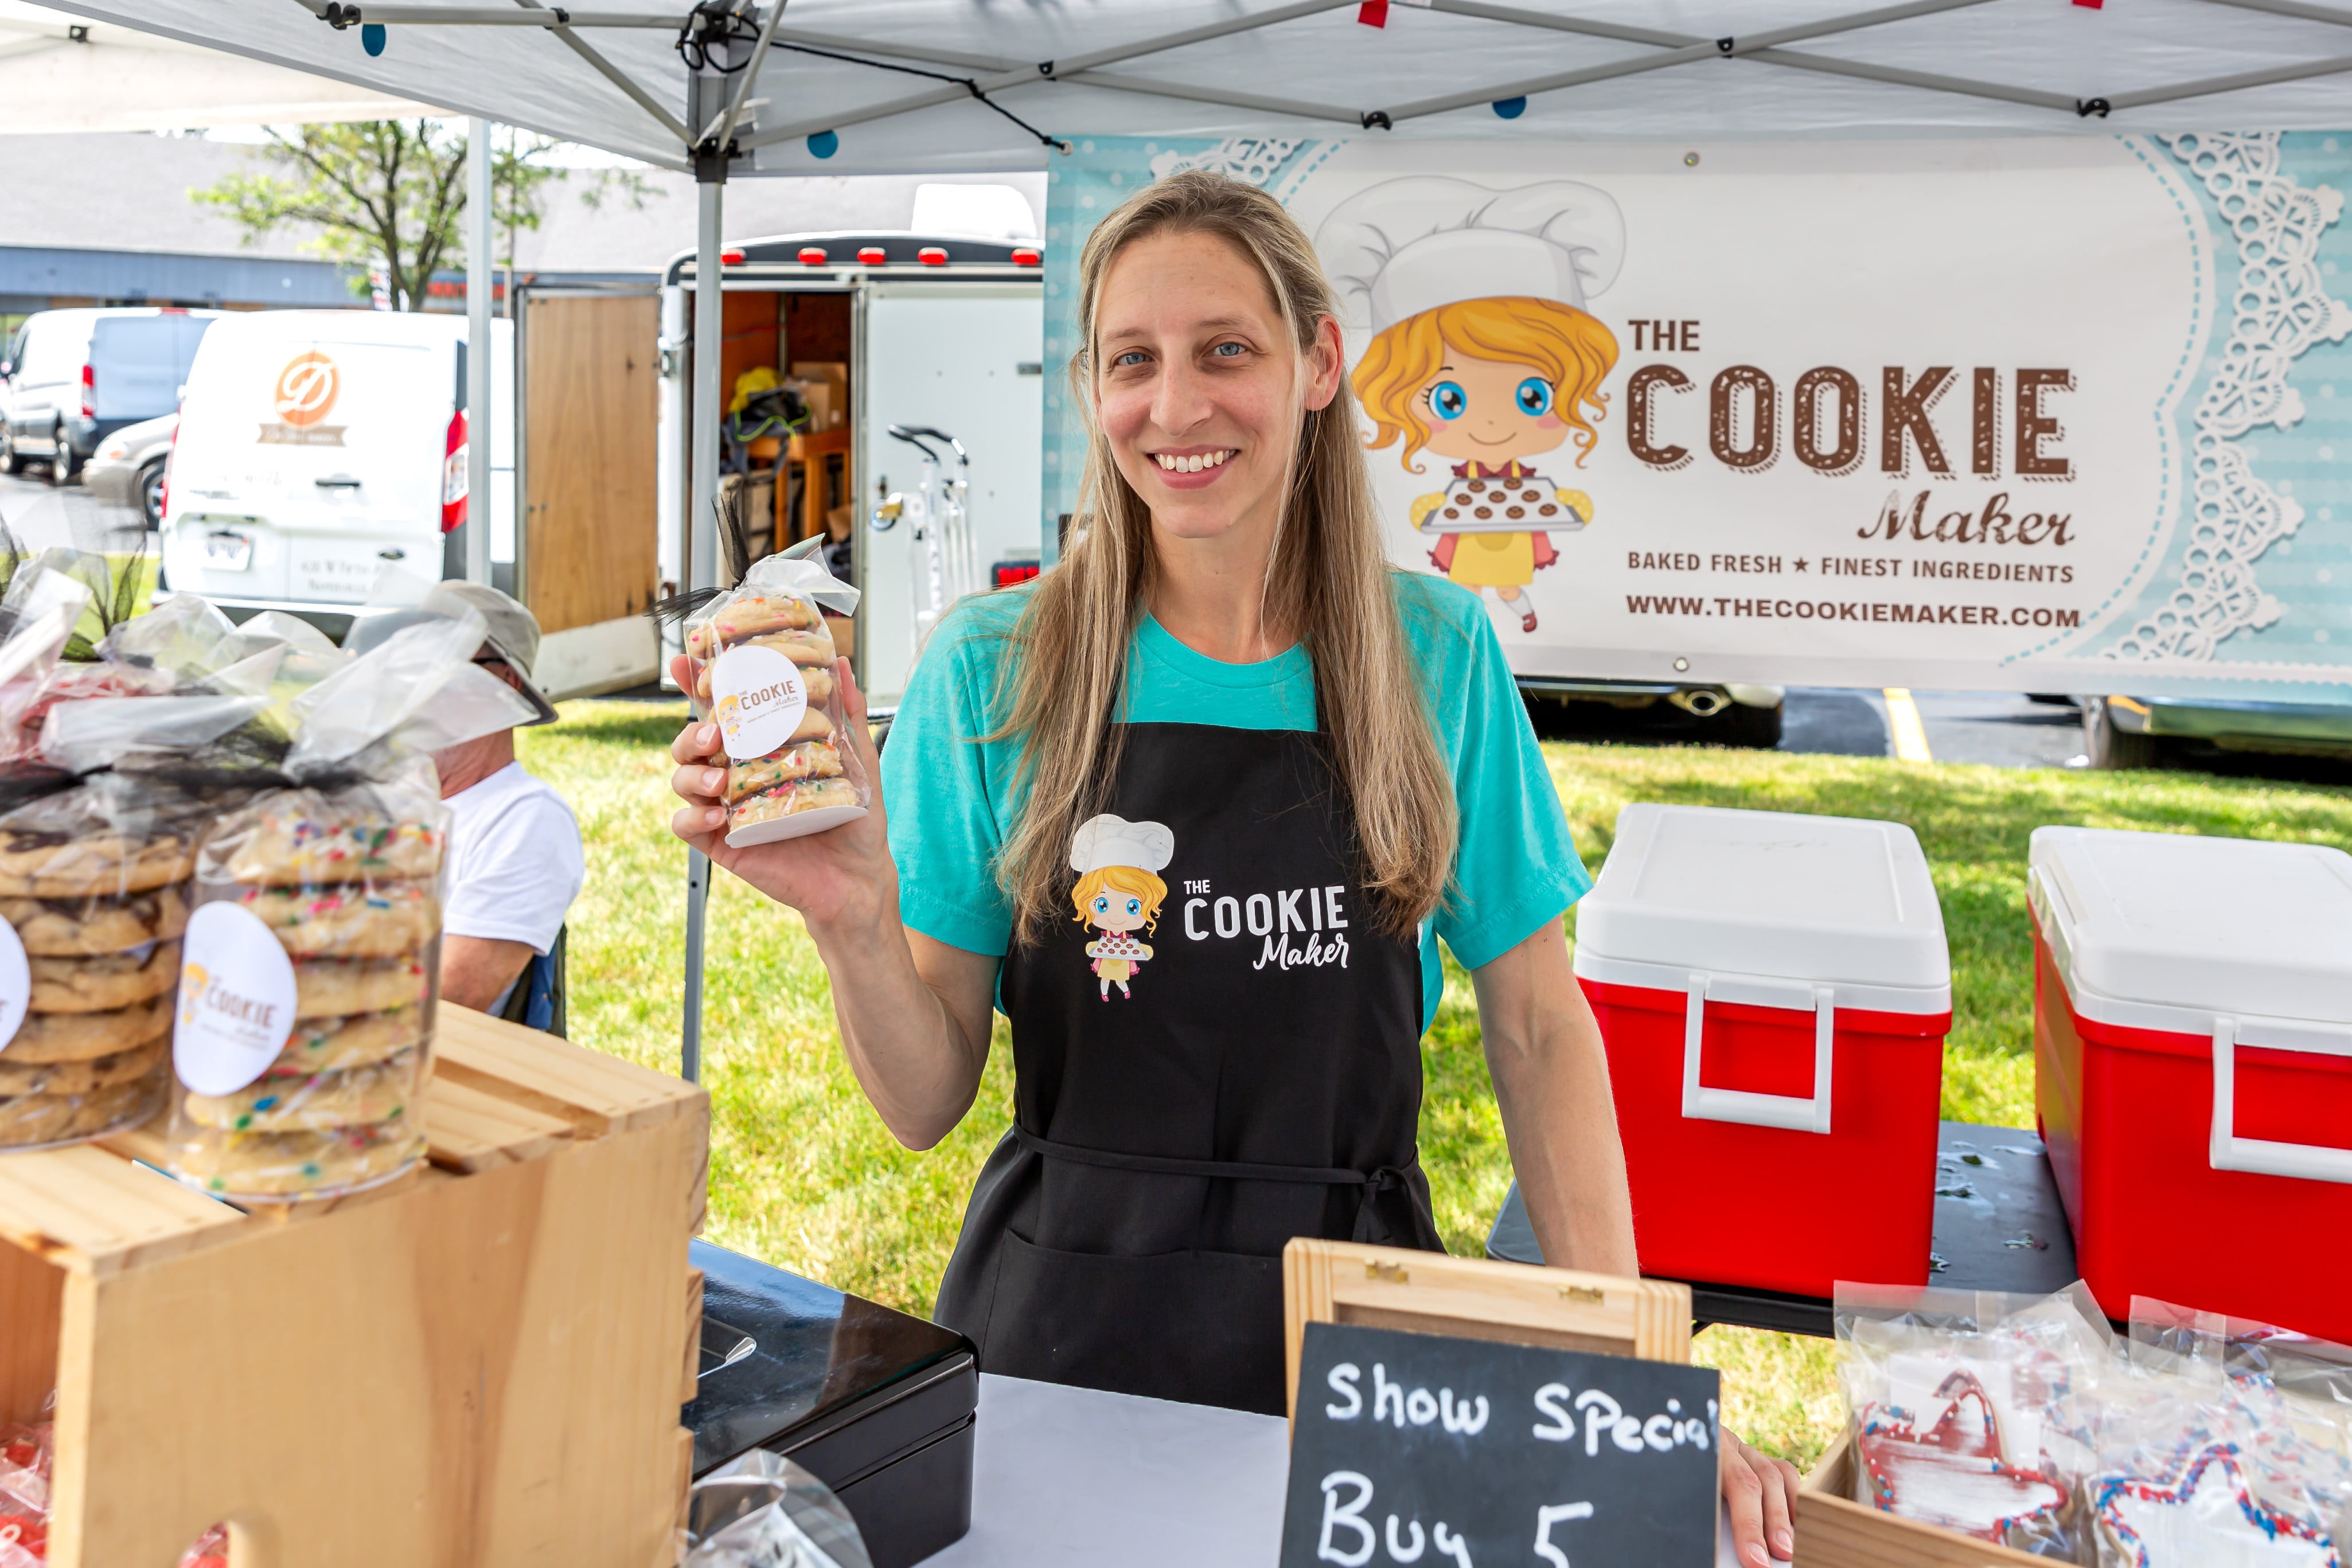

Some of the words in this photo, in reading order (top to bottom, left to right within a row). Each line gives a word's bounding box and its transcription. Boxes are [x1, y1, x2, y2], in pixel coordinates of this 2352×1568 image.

[1628, 319, 1700, 351] THE
[1626, 364, 2077, 482] COOKIE
[1857, 489, 2076, 545] Maker
[1628, 552, 1700, 571] BAKED
[1711, 554, 1782, 574] FRESH
[1821, 557, 1902, 577] FINEST
[1913, 559, 2074, 583] INGREDIENTS
[1626, 595, 2081, 628] WWW.THECOOKIEMAKER.COM
[740, 680, 796, 710] COOKIE
[1184, 879, 1211, 895] THE
[1184, 886, 1348, 941] COOKIE
[1253, 933, 1348, 970] Maker
[206, 985, 278, 1029] COOKIE
[1317, 1469, 1474, 1568] Buy
[1533, 1501, 1594, 1568] 5
